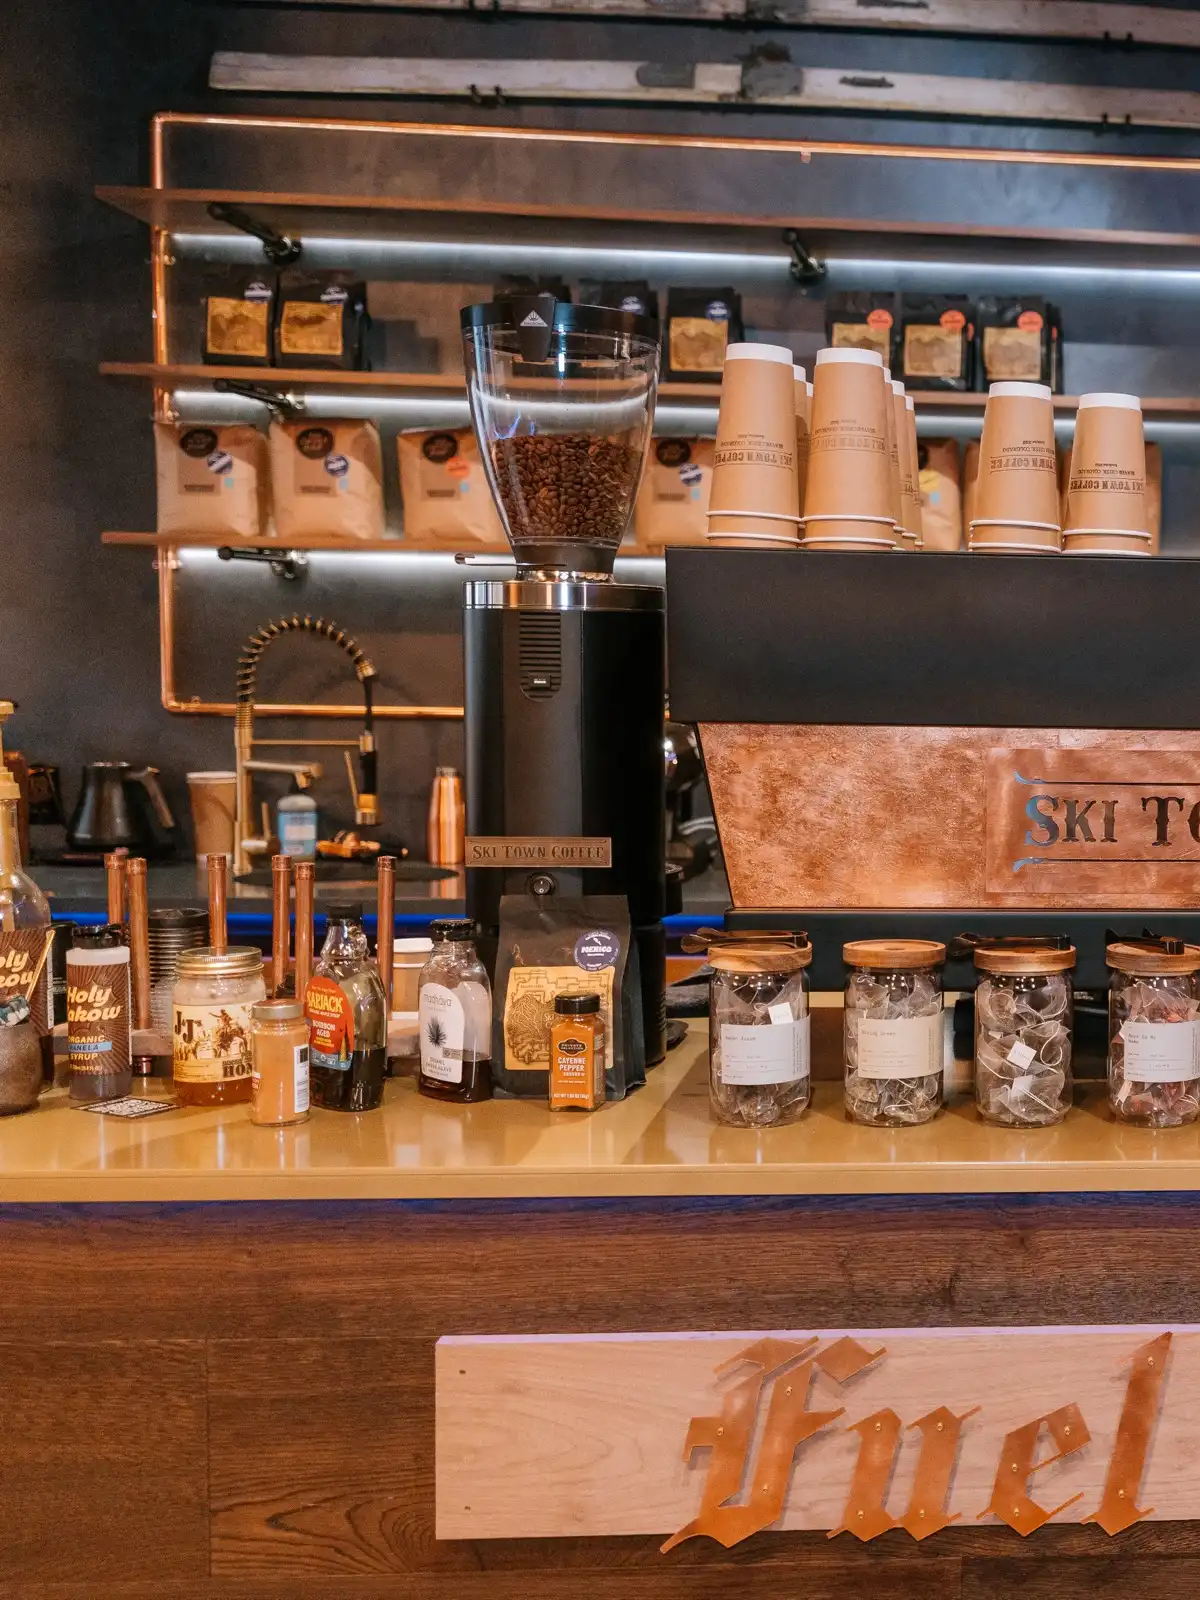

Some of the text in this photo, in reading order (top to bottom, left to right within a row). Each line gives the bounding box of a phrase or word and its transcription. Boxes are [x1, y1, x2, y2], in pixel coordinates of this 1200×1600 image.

[1024, 793, 1118, 847] SKI
[500, 845, 546, 859] TOWN
[551, 845, 604, 859] COFFEE
[68, 1004, 122, 1022] akow
[70, 1053, 98, 1061] SYRUP
[557, 1057, 586, 1065] CAYENNE
[559, 1064, 585, 1072] PEPPER
[660, 1331, 1174, 1555] Fuel
